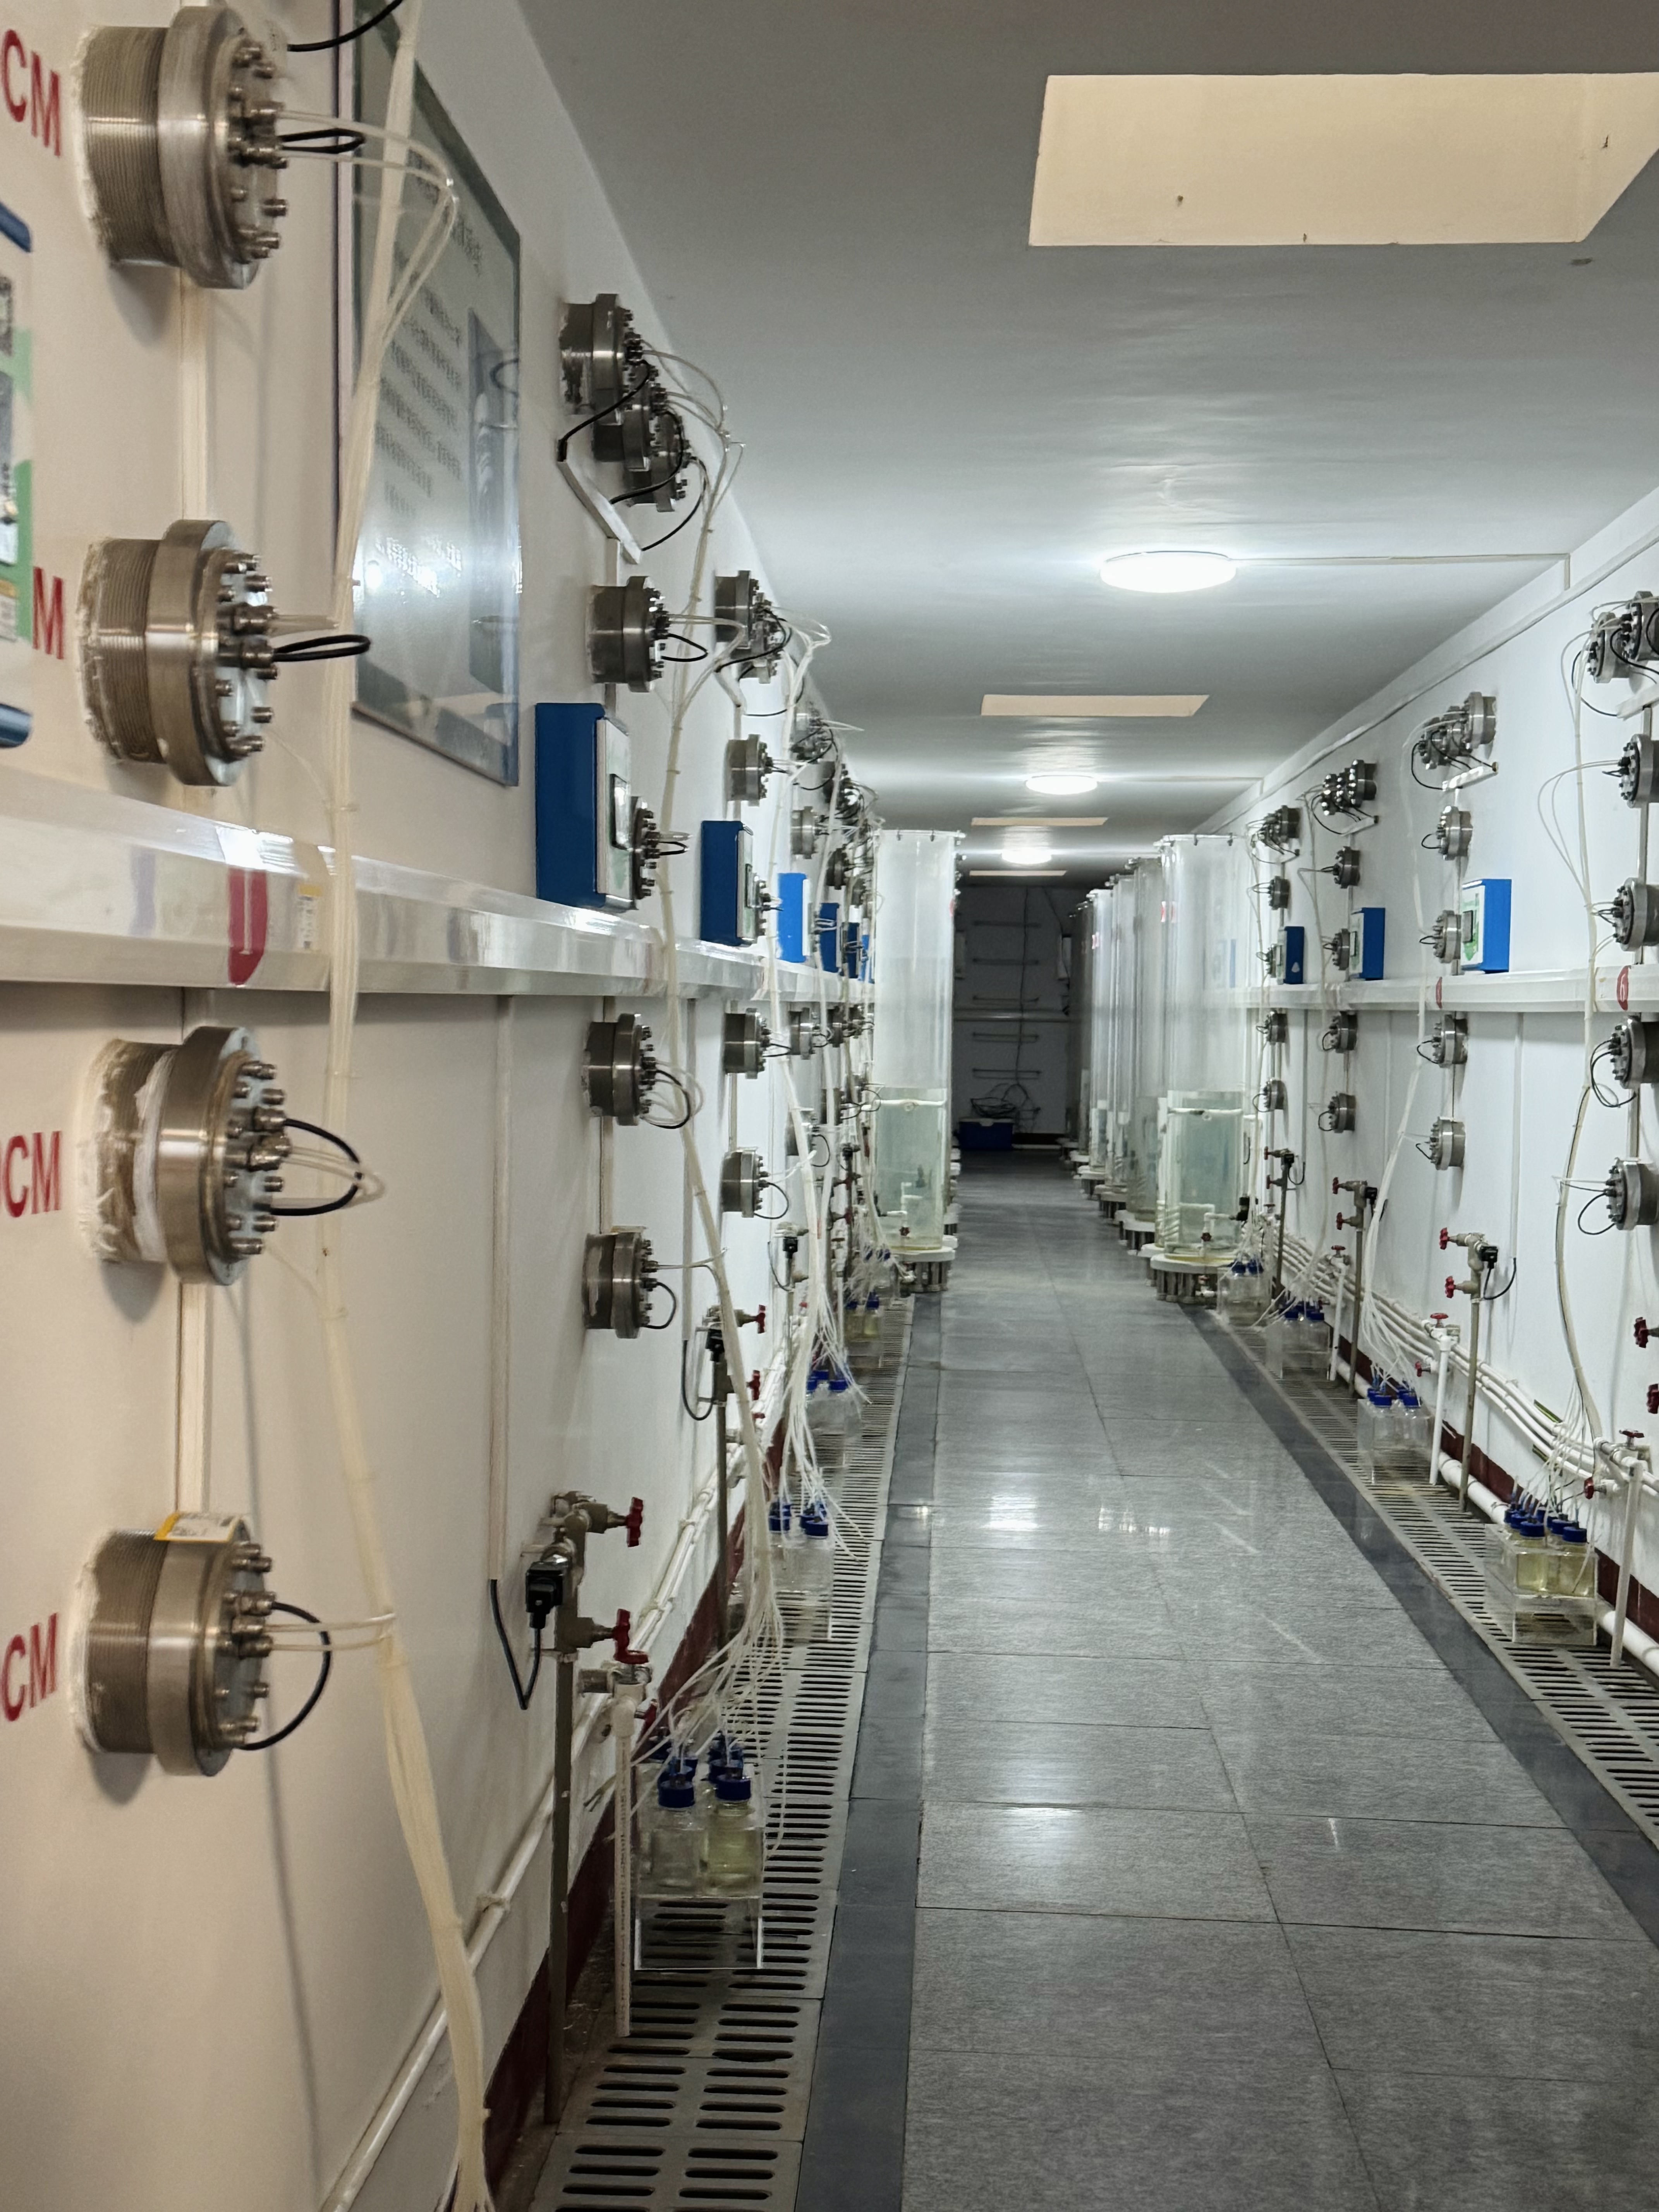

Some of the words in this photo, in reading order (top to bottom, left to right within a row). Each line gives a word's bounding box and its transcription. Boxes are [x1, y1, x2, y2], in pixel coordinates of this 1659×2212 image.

[2, 29, 61, 156] CM
[3, 1131, 62, 1218] CM
[2, 1612, 58, 1722] CM
